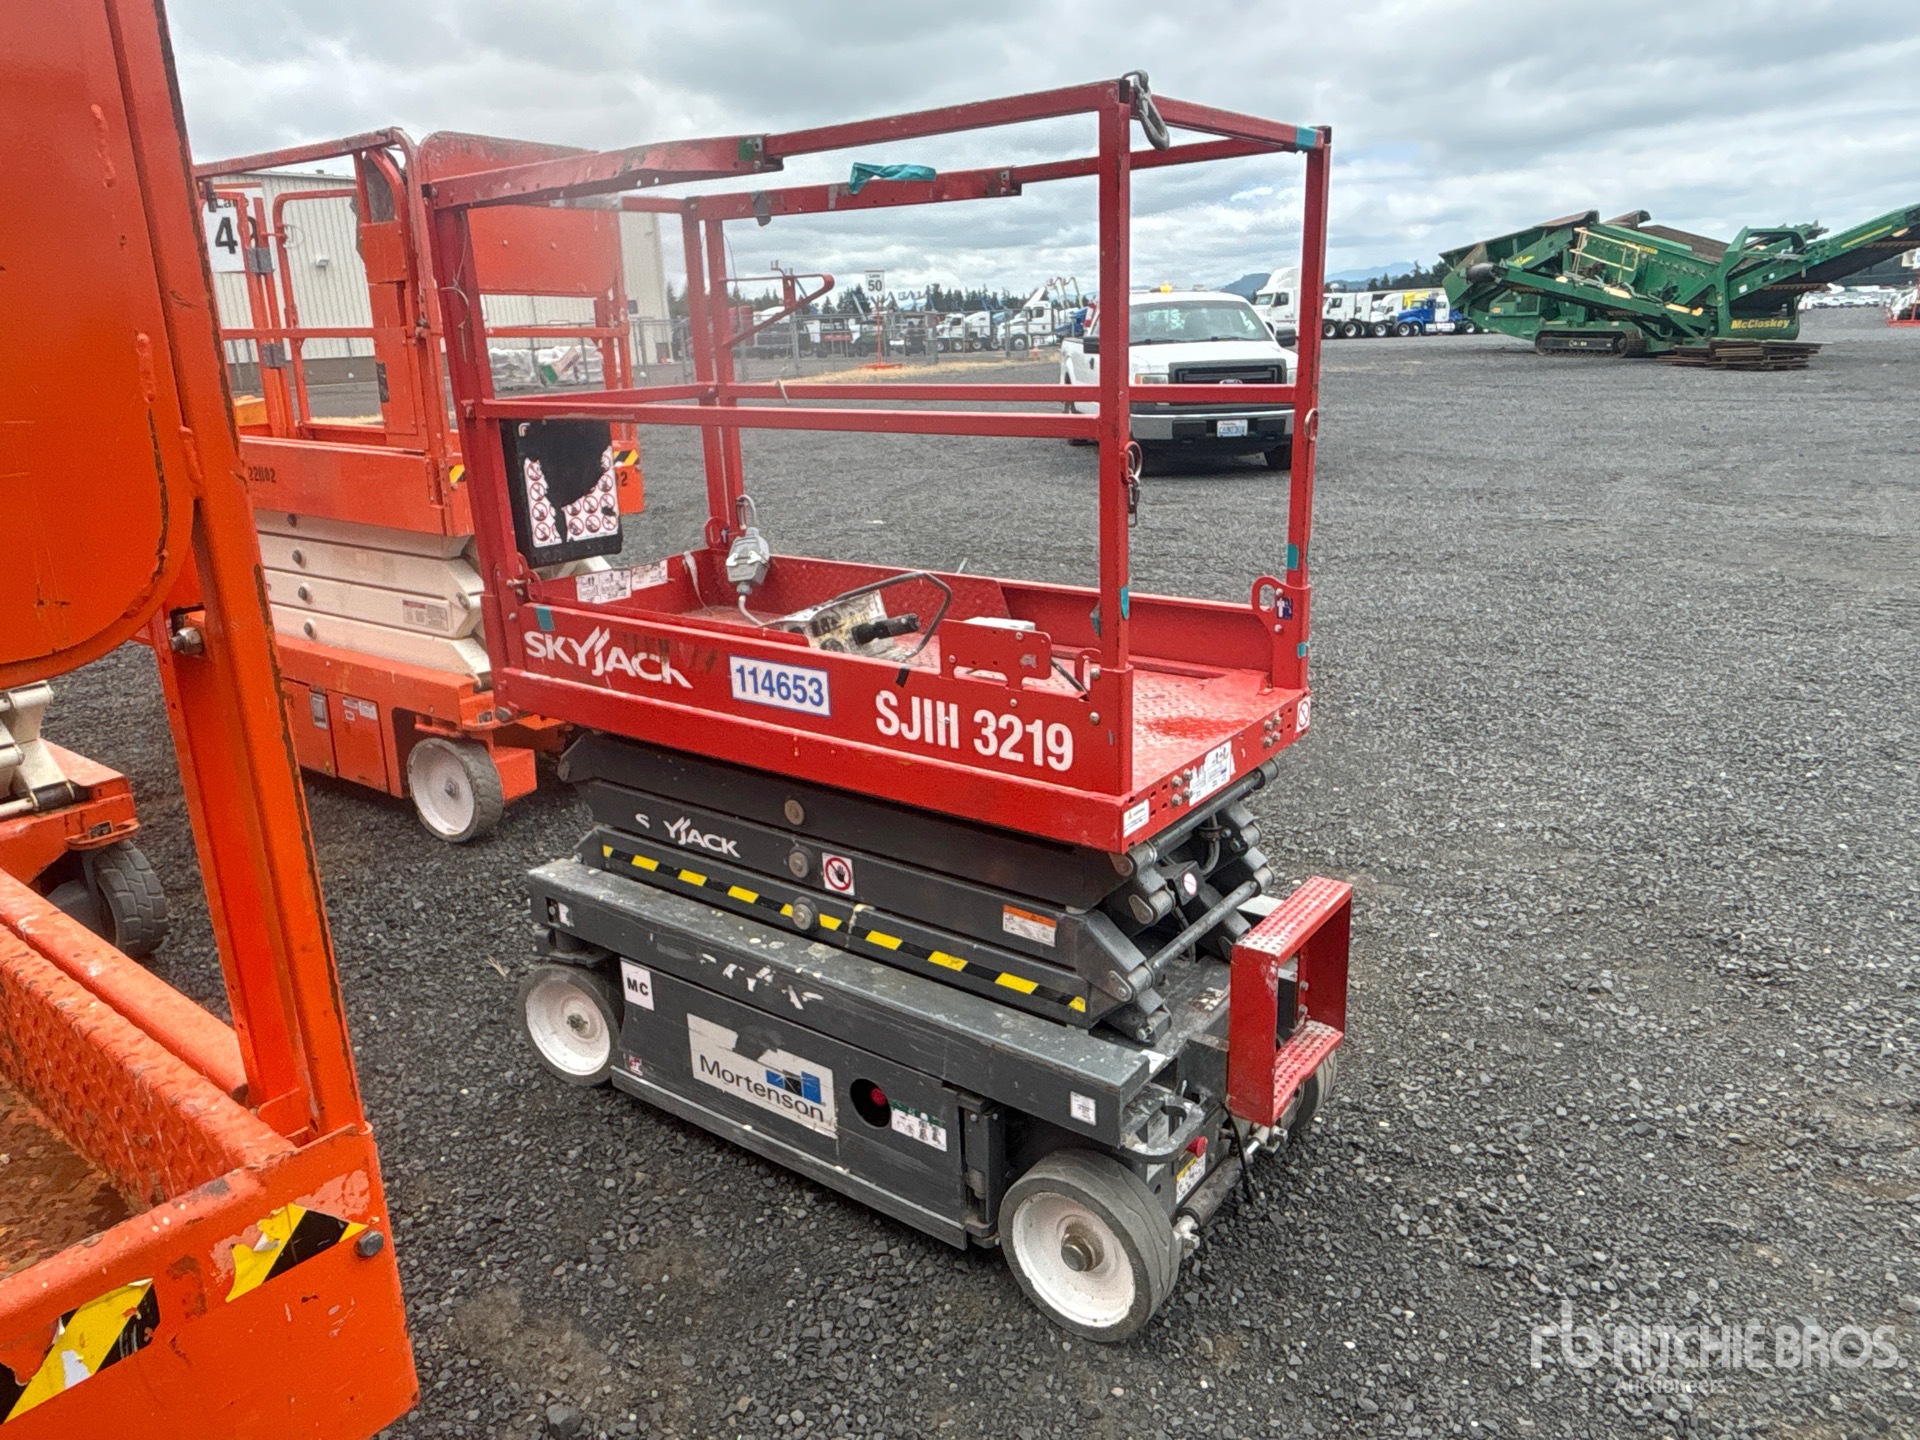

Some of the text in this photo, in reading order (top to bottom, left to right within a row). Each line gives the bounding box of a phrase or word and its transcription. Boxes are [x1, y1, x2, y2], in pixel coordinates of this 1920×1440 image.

[868, 279, 882, 292] 50
[1731, 319, 1790, 329] McCloskey
[523, 625, 694, 689] SKYJACK
[735, 664, 825, 708] 114653
[973, 709, 1074, 772] 3219
[626, 976, 649, 996] MC
[699, 1054, 825, 1123] Mortenson
